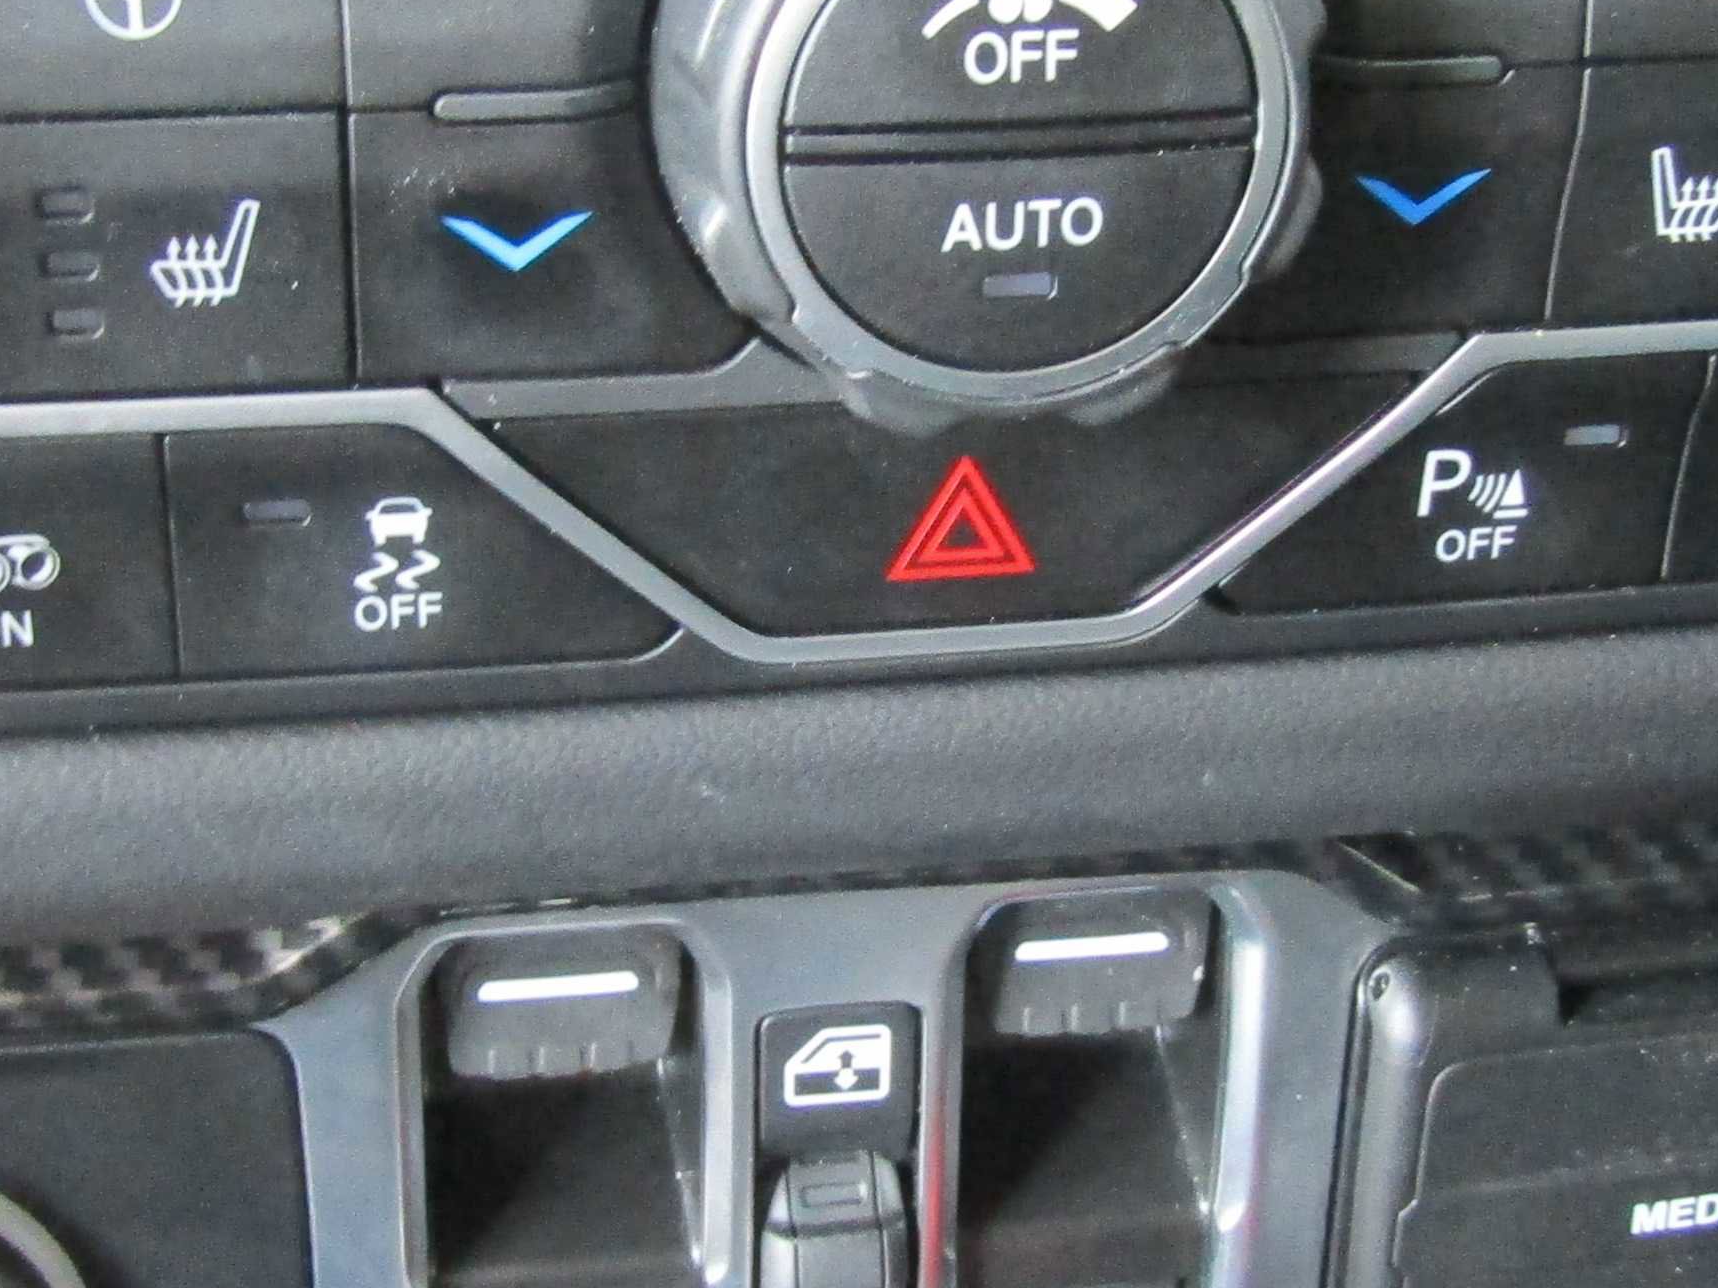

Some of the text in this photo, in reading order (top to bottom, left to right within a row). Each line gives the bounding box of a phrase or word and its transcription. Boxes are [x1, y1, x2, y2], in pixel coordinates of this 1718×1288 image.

[963, 26, 1079, 86] OFF
[941, 196, 1105, 253] AUTO
[1435, 524, 1517, 563] OFF
[354, 592, 444, 633] OFF
